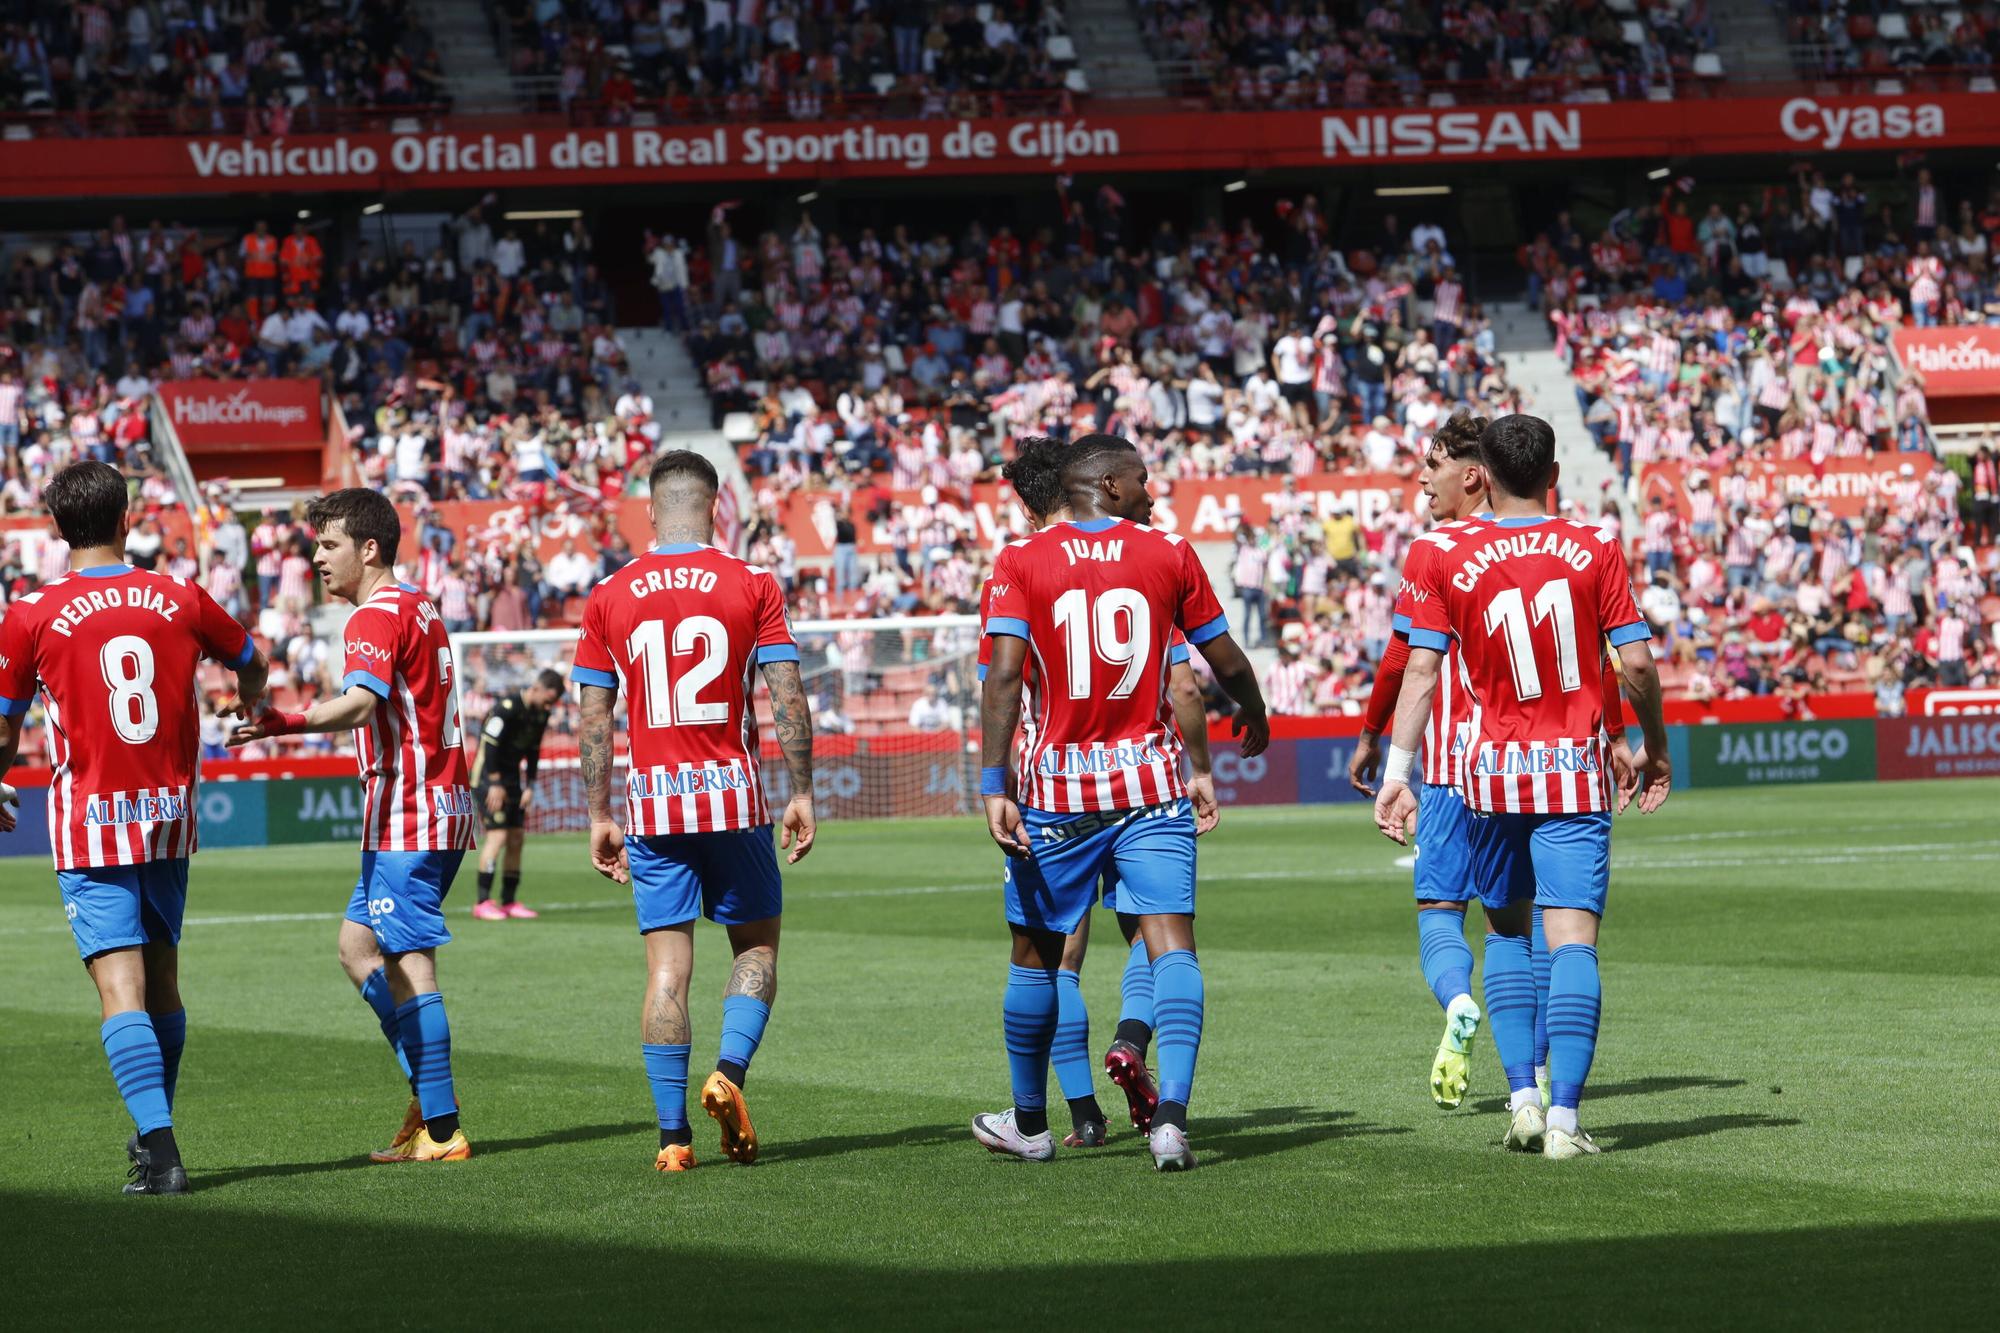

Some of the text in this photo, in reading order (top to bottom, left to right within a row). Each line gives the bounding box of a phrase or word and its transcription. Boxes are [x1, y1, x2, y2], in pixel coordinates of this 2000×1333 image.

[1322, 109, 1581, 157] NISSAN
[1780, 98, 1944, 149] Cyasa
[188, 119, 1119, 176] Vehículo Oficial del Real Sporting de Gijón
[1907, 336, 1990, 371] Halcón
[174, 388, 262, 424] Halcón
[1060, 538, 1124, 566] JUAN
[1452, 532, 1593, 593] CAMPUZANO
[629, 567, 717, 599] CRISTO
[51, 585, 179, 637] PEDRO DÍAZ
[1051, 587, 1150, 700] 19
[1483, 578, 1581, 702] 11
[99, 635, 158, 744] 8
[626, 615, 729, 728] 12
[1717, 728, 1849, 764] JALISCO
[1906, 722, 2000, 757] JALISC
[1038, 742, 1166, 775] ALIMERKA
[1474, 746, 1599, 775] ALIMERKA
[630, 766, 750, 799] ALIMERKA
[85, 797, 188, 827] ALIMERKA
